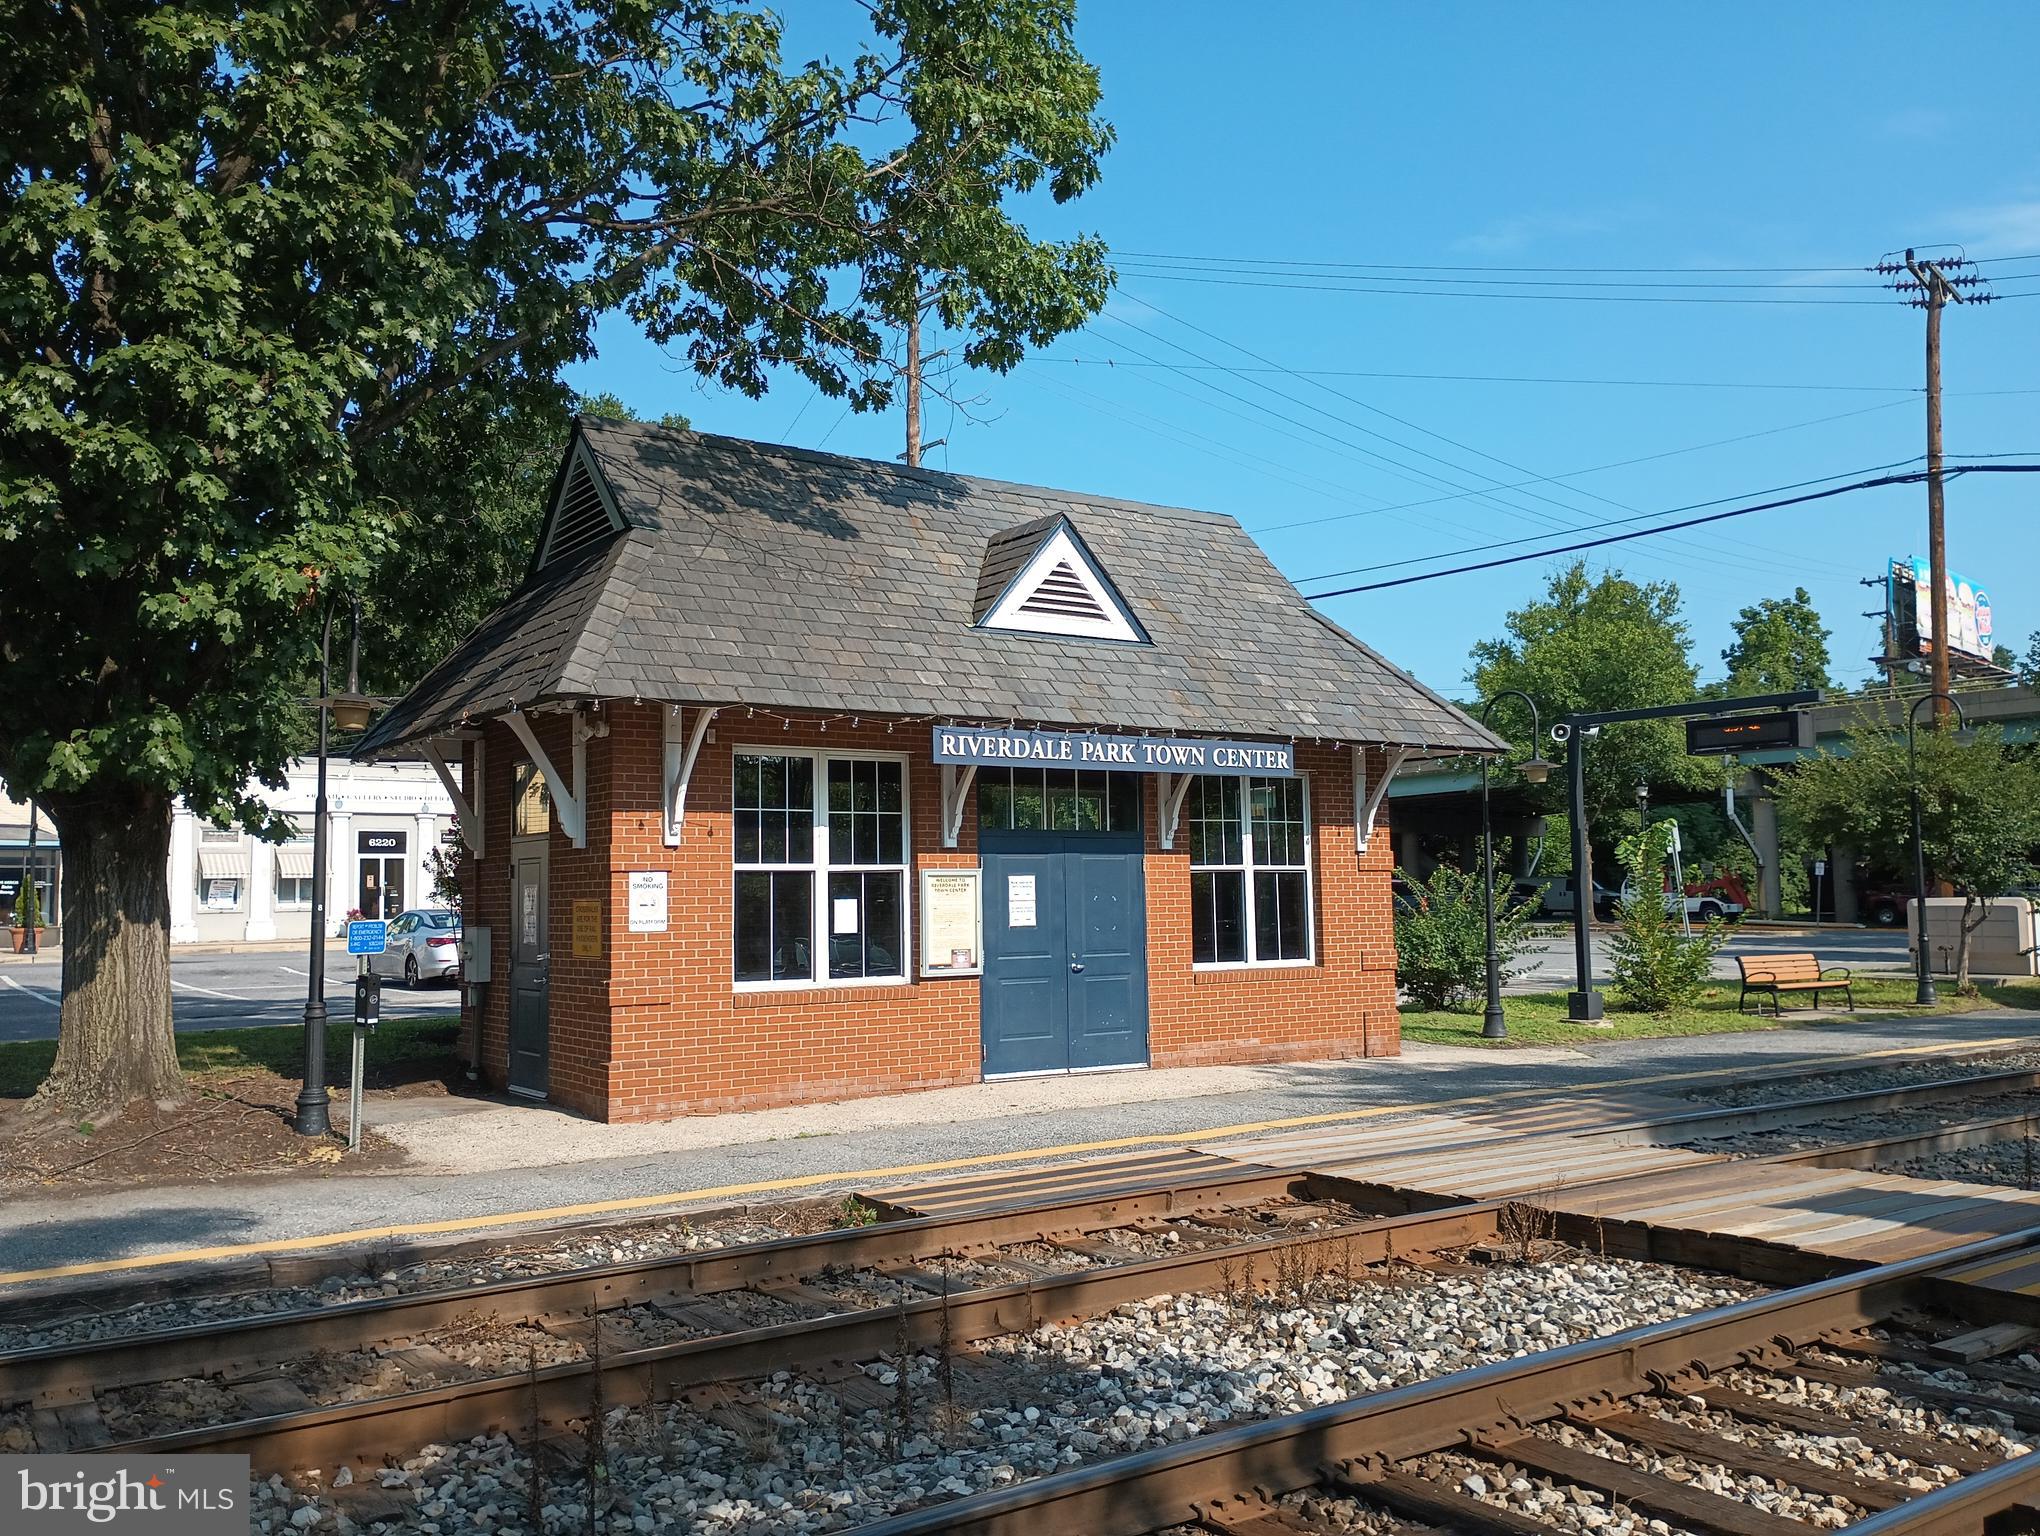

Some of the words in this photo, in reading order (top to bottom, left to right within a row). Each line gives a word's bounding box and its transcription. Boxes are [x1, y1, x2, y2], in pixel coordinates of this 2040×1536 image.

[941, 733, 1073, 761] RIVERDALE
[1081, 741, 1137, 764] PARK
[1143, 744, 1206, 766] TOWN
[1212, 747, 1290, 770] CENTER
[368, 838, 396, 847] 6220
